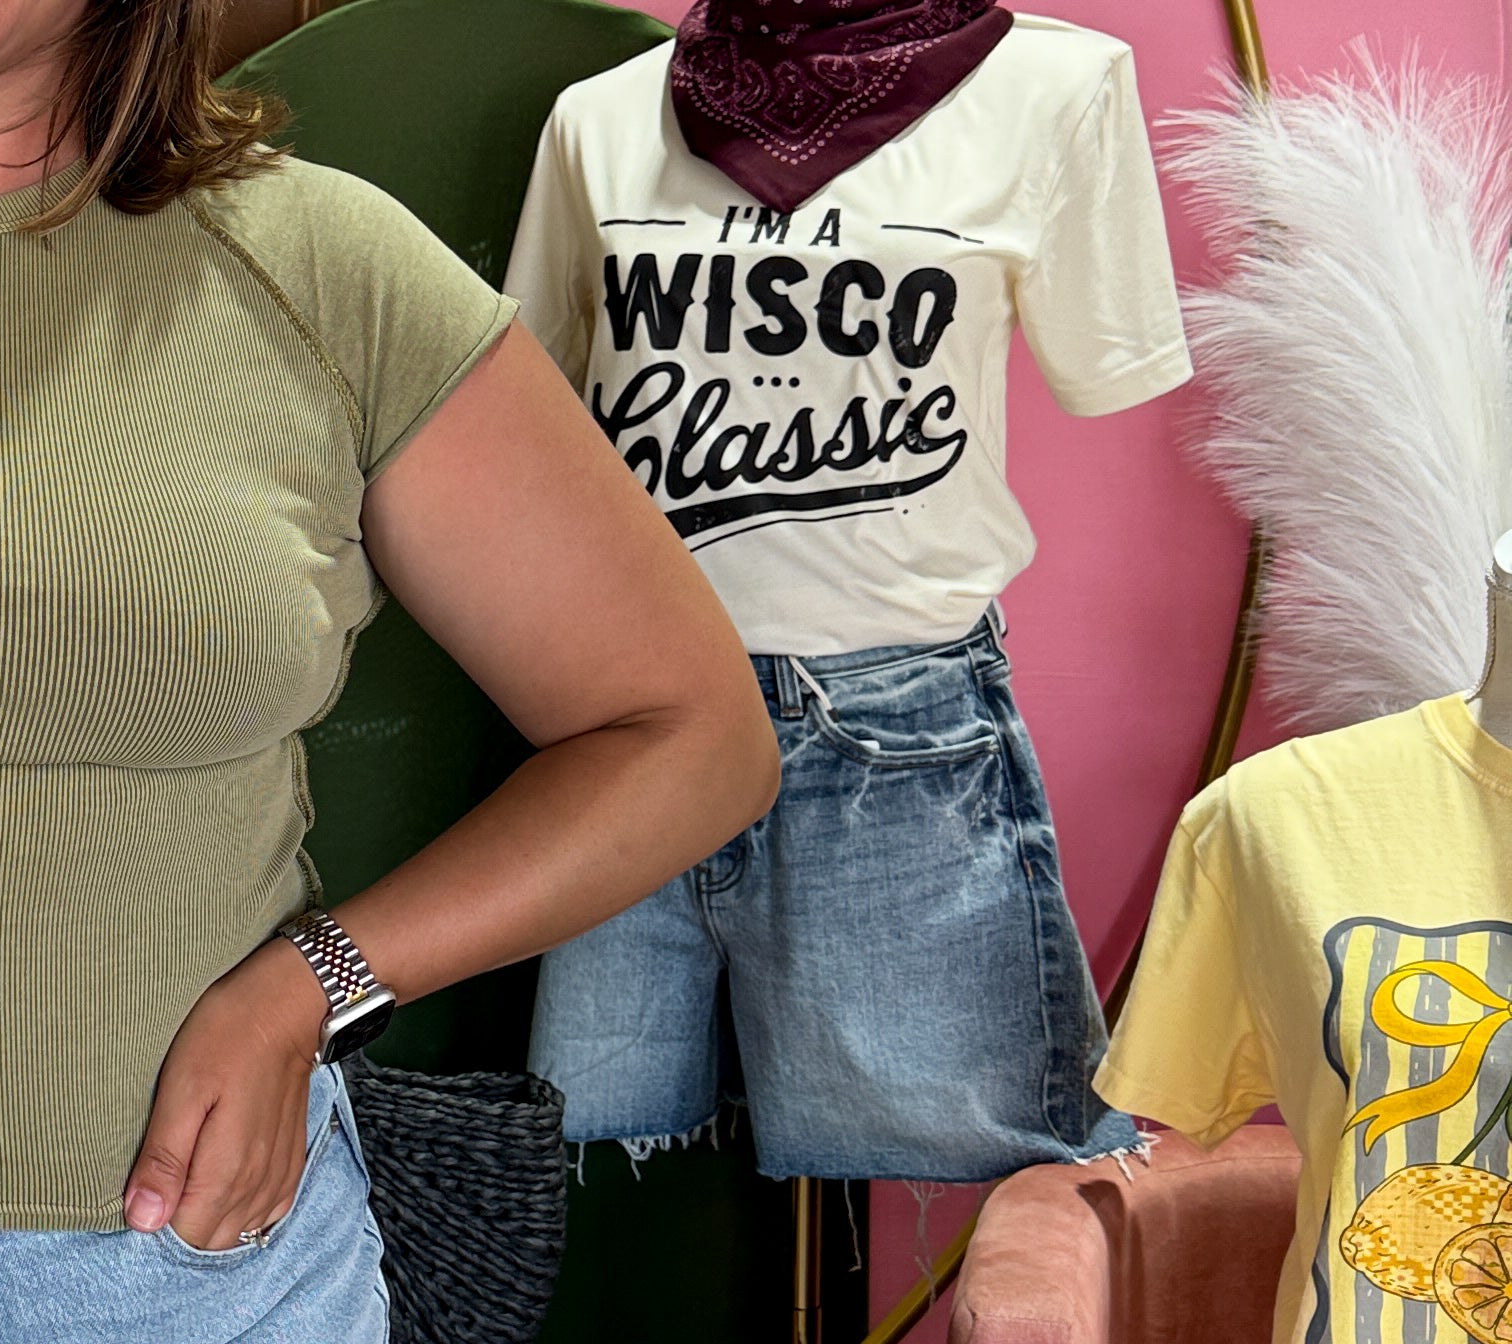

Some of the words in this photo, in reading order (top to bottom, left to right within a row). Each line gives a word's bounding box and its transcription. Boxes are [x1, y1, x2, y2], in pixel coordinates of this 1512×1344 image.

[717, 206, 792, 244] I'M
[808, 208, 841, 247] A
[604, 253, 957, 369] WISCO
[592, 361, 967, 500] Classic
